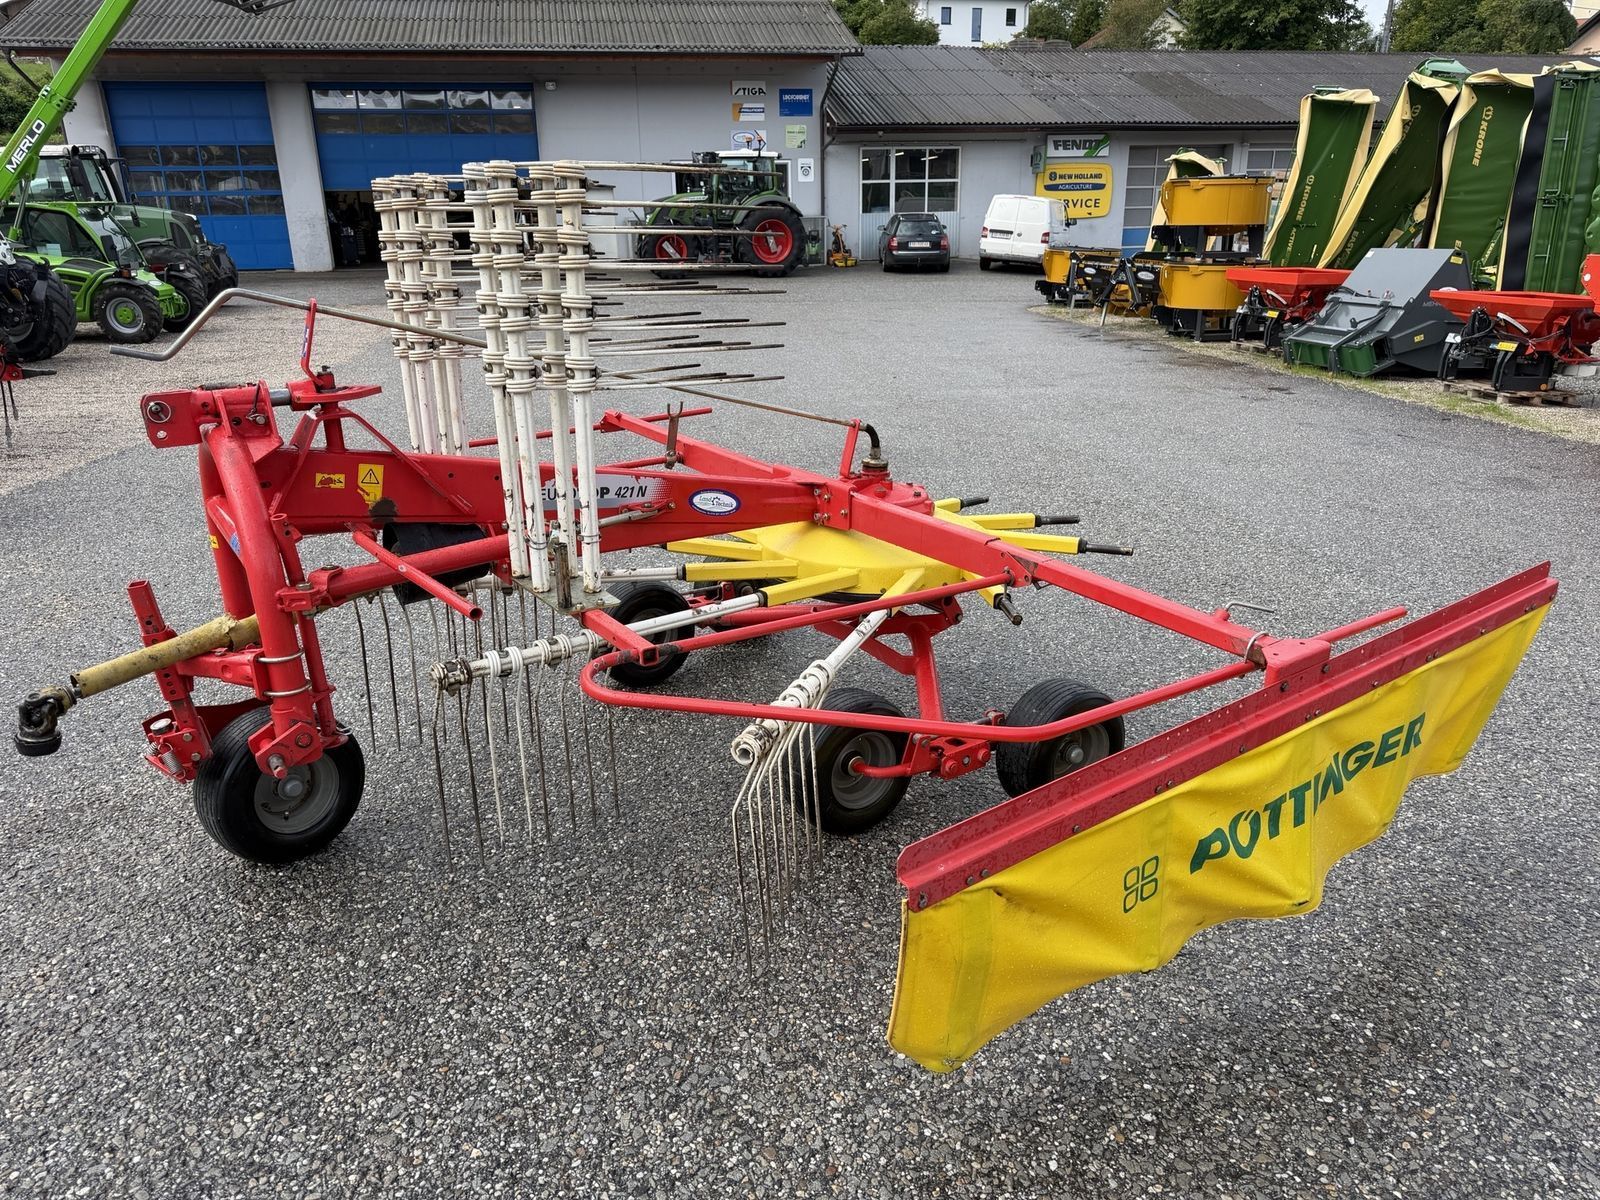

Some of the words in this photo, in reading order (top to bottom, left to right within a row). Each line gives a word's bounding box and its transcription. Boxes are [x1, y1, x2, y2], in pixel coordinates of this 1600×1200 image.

[735, 87, 766, 95] STIGA
[5, 119, 46, 173] MERLO
[1052, 140, 1101, 151] FENDT
[1472, 120, 1489, 168] KRONE
[1059, 199, 1101, 209] RVICE
[1296, 185, 1312, 222] KRONE
[614, 486, 635, 499] 421
[636, 485, 648, 498] N
